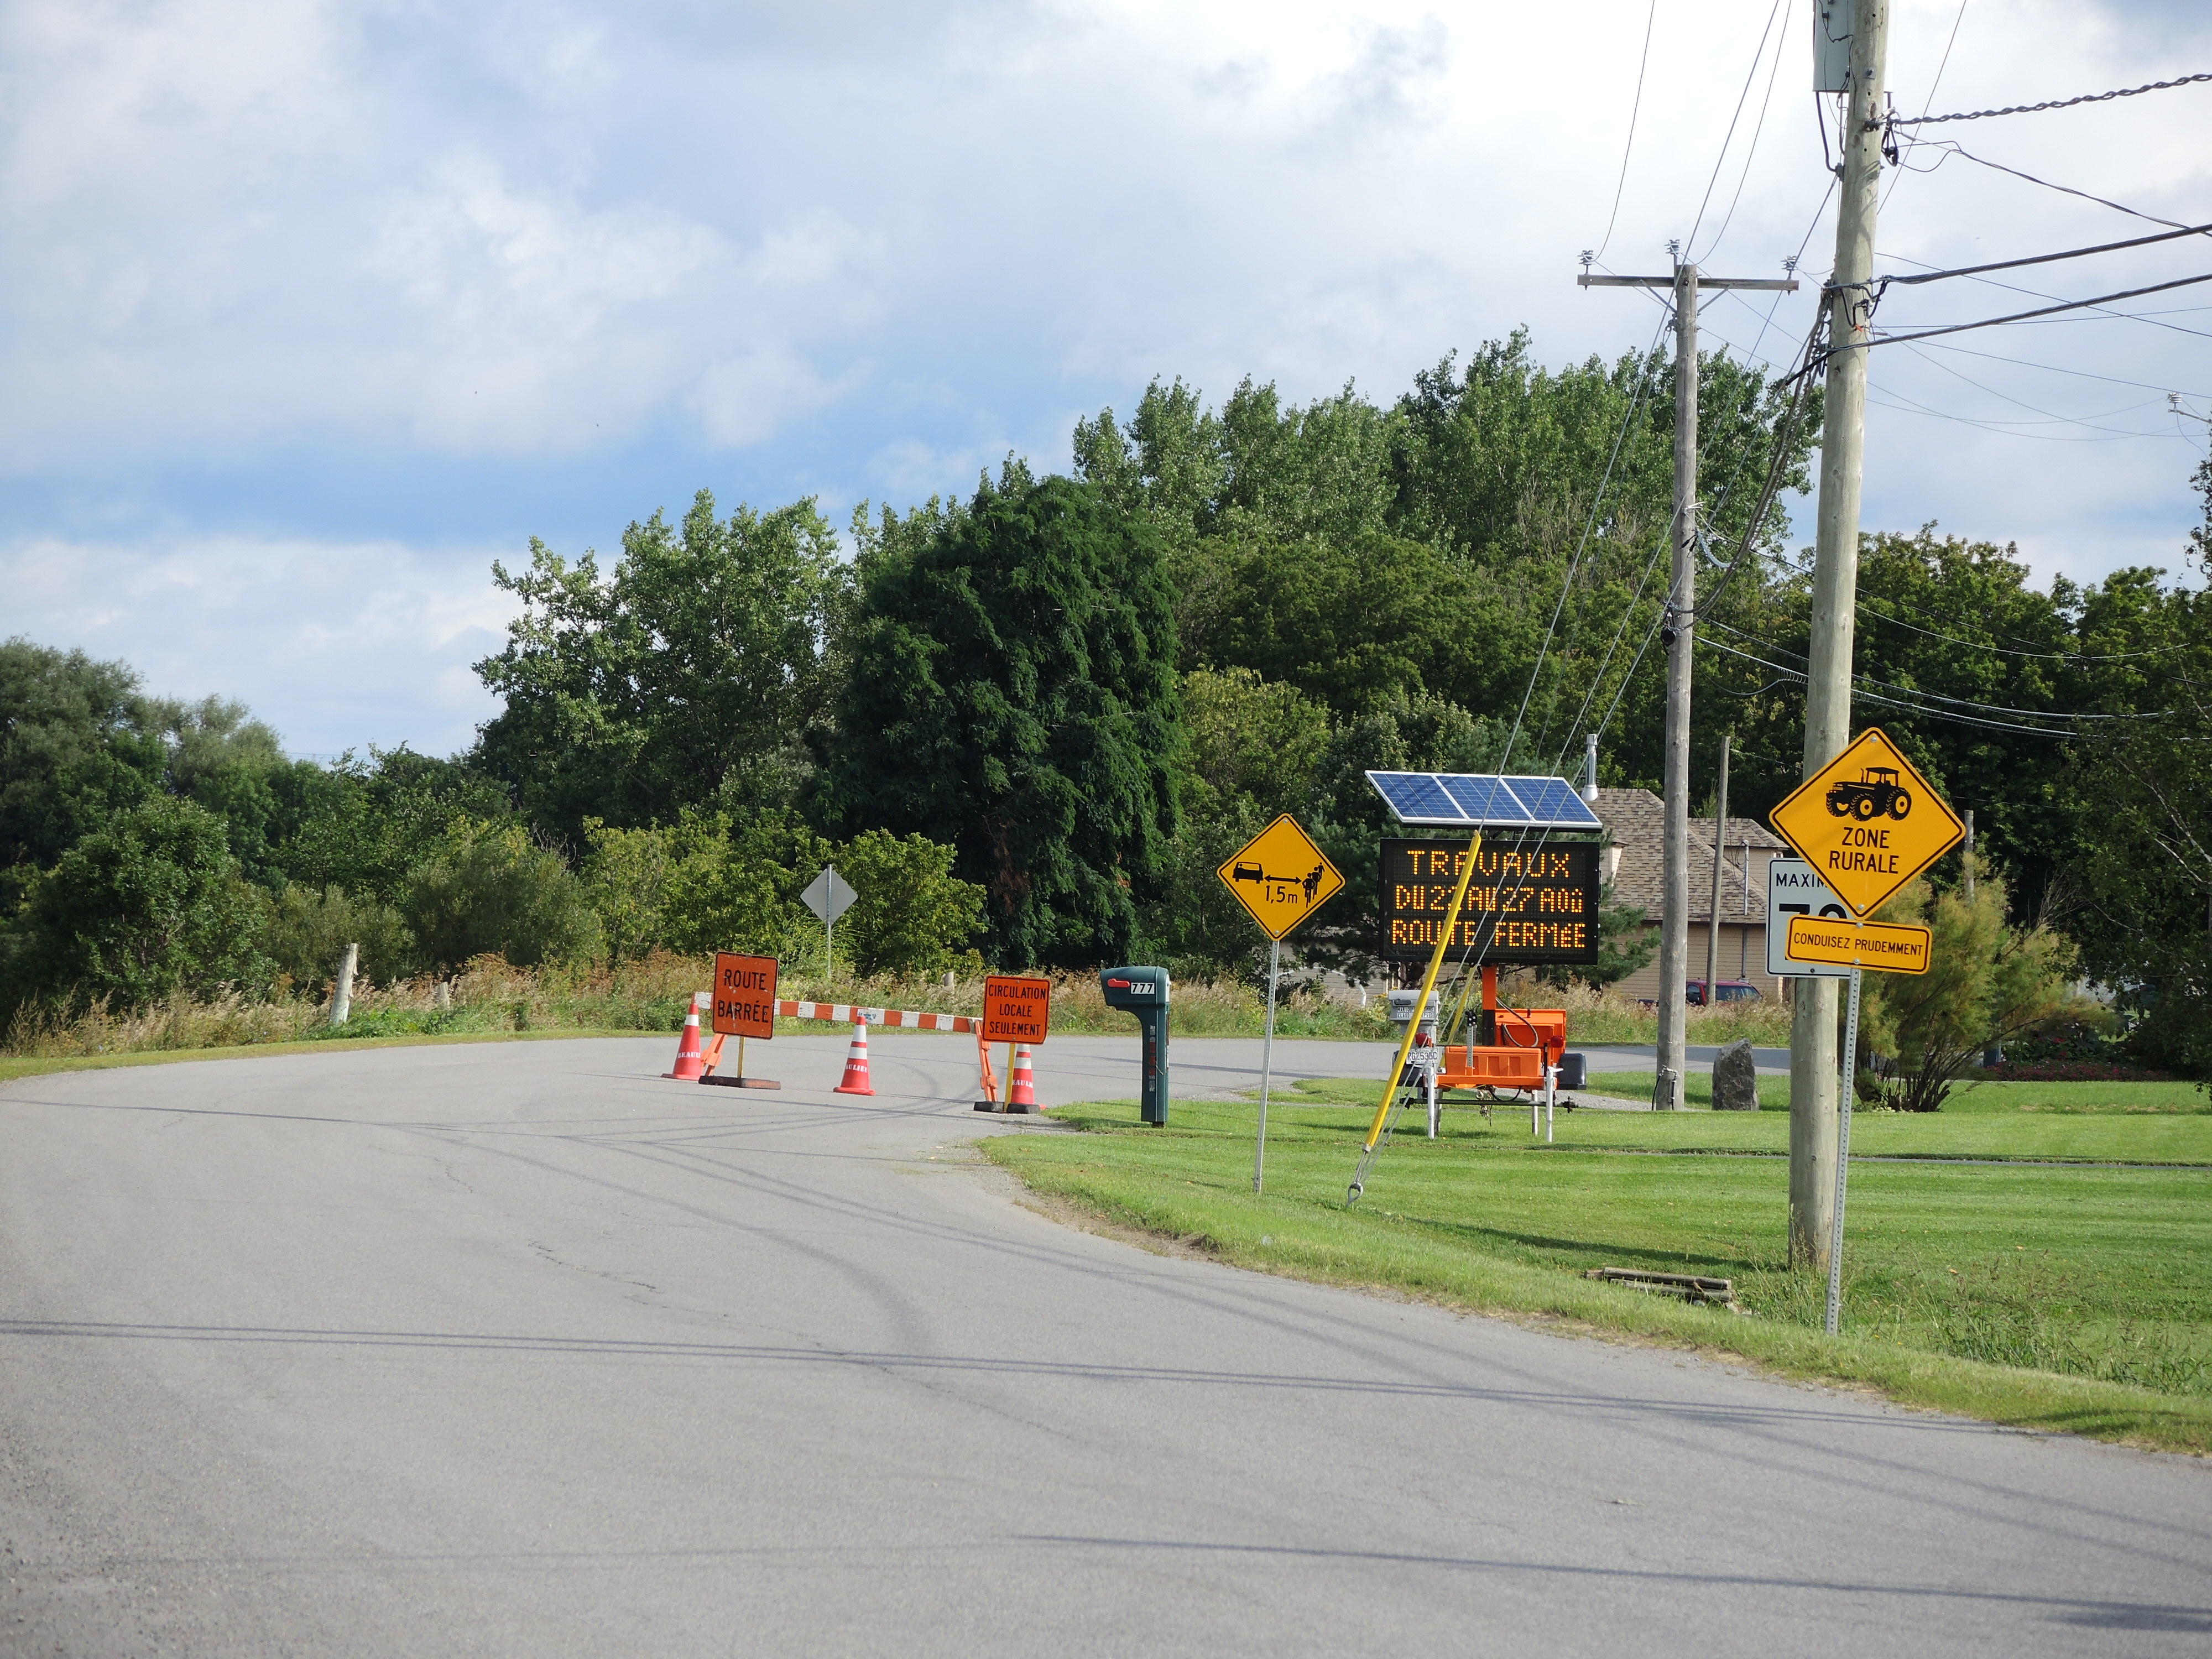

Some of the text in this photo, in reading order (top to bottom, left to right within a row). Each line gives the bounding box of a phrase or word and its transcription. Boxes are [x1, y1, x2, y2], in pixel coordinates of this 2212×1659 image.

[1842, 827, 1890, 848] ZONE
[1407, 851, 1569, 878] TRAVAUX
[1829, 851, 1899, 874] RURALE
[1396, 885, 1425, 910] DU
[1468, 886, 1496, 911] AU
[1503, 887, 1534, 912] 27
[1392, 920, 1475, 946] ROUTE
[1794, 932, 1923, 956] CONDUISEZ PRUDEMMENT
[724, 969, 766, 990] ROUTE
[1132, 983, 1153, 993] 777
[988, 984, 1046, 1000] CIRCULATION
[717, 1000, 769, 1023] BARRÉE
[999, 1004, 1032, 1017] LOCALE
[989, 1021, 1041, 1036] SEULEMENT
